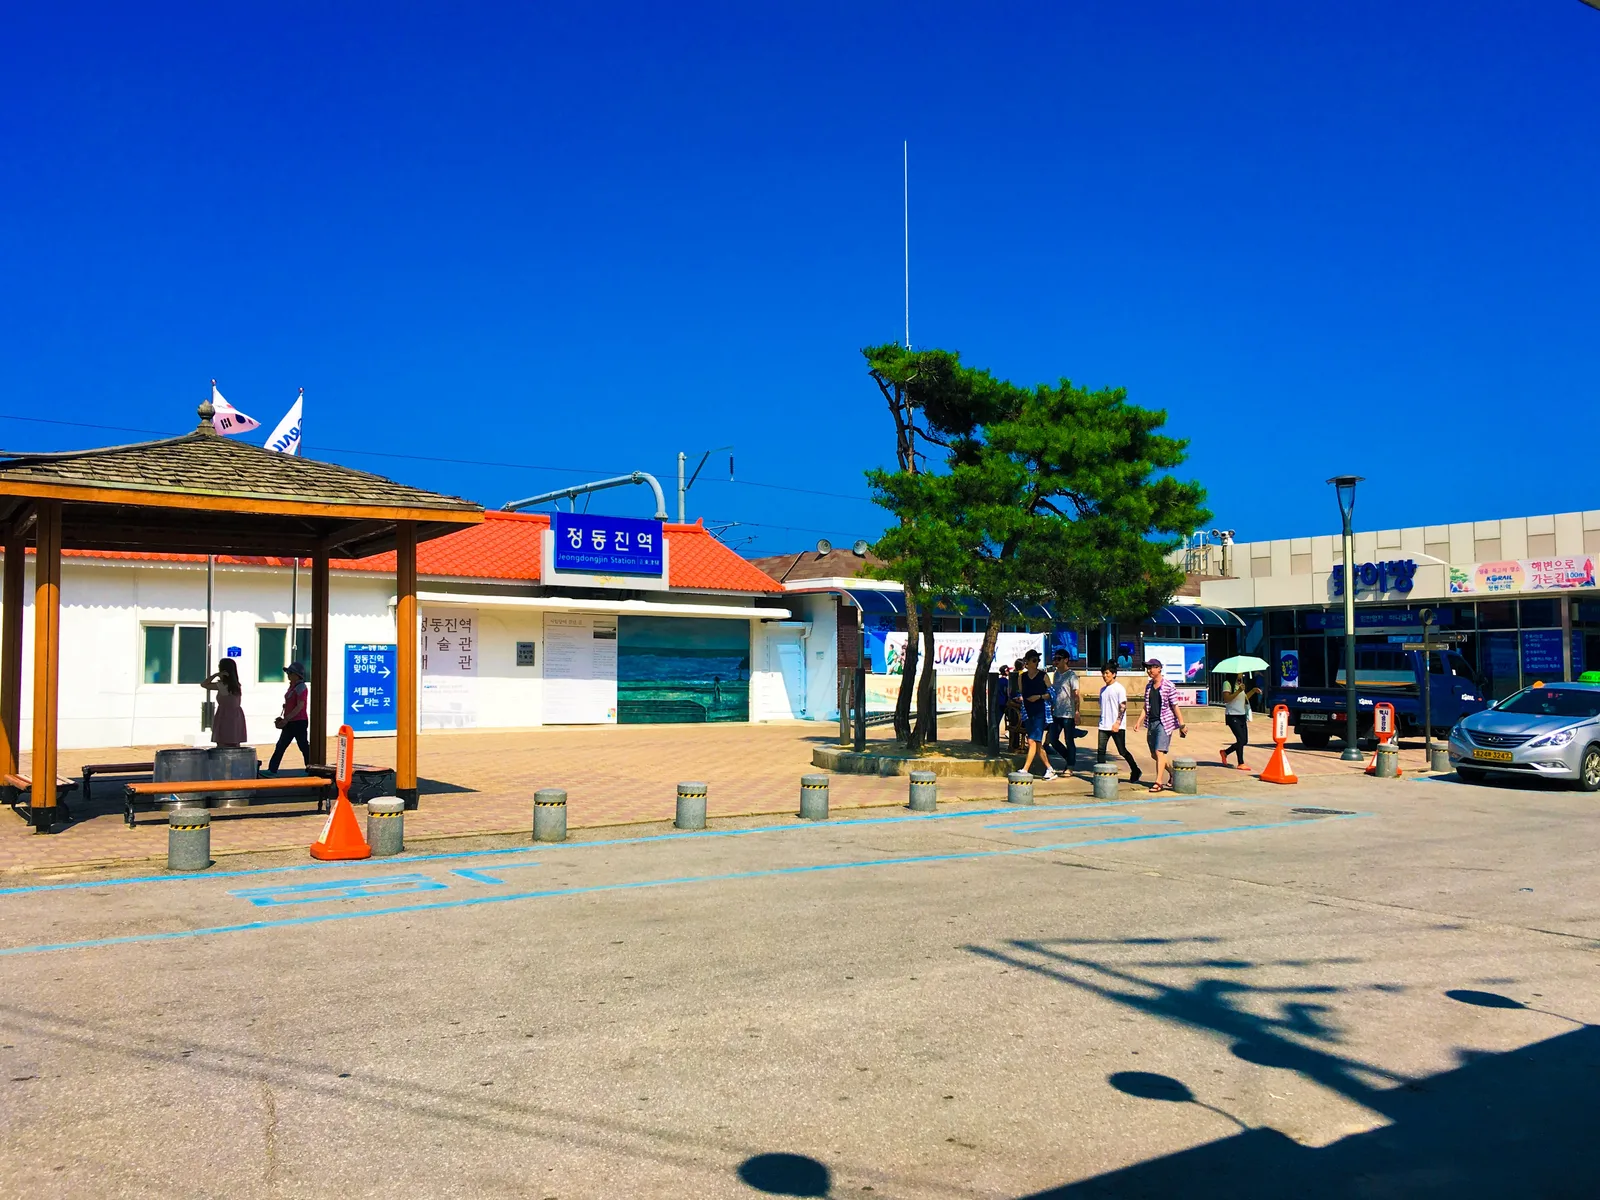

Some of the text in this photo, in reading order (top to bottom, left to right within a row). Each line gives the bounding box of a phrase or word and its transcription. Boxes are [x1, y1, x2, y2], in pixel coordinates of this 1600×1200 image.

[567, 527, 653, 554] 정동진역
[558, 553, 609, 564] Jeongdongjin
[610, 556, 636, 565] Station
[1531, 559, 1576, 572] 해변으로
[1486, 574, 1513, 582] KORAIL
[353, 654, 385, 664] 정동진역
[935, 644, 975, 665] SOUND
[353, 664, 377, 674] 맞이방
[364, 697, 391, 707] 타는 곳
[1296, 695, 1322, 704] KORAIL
